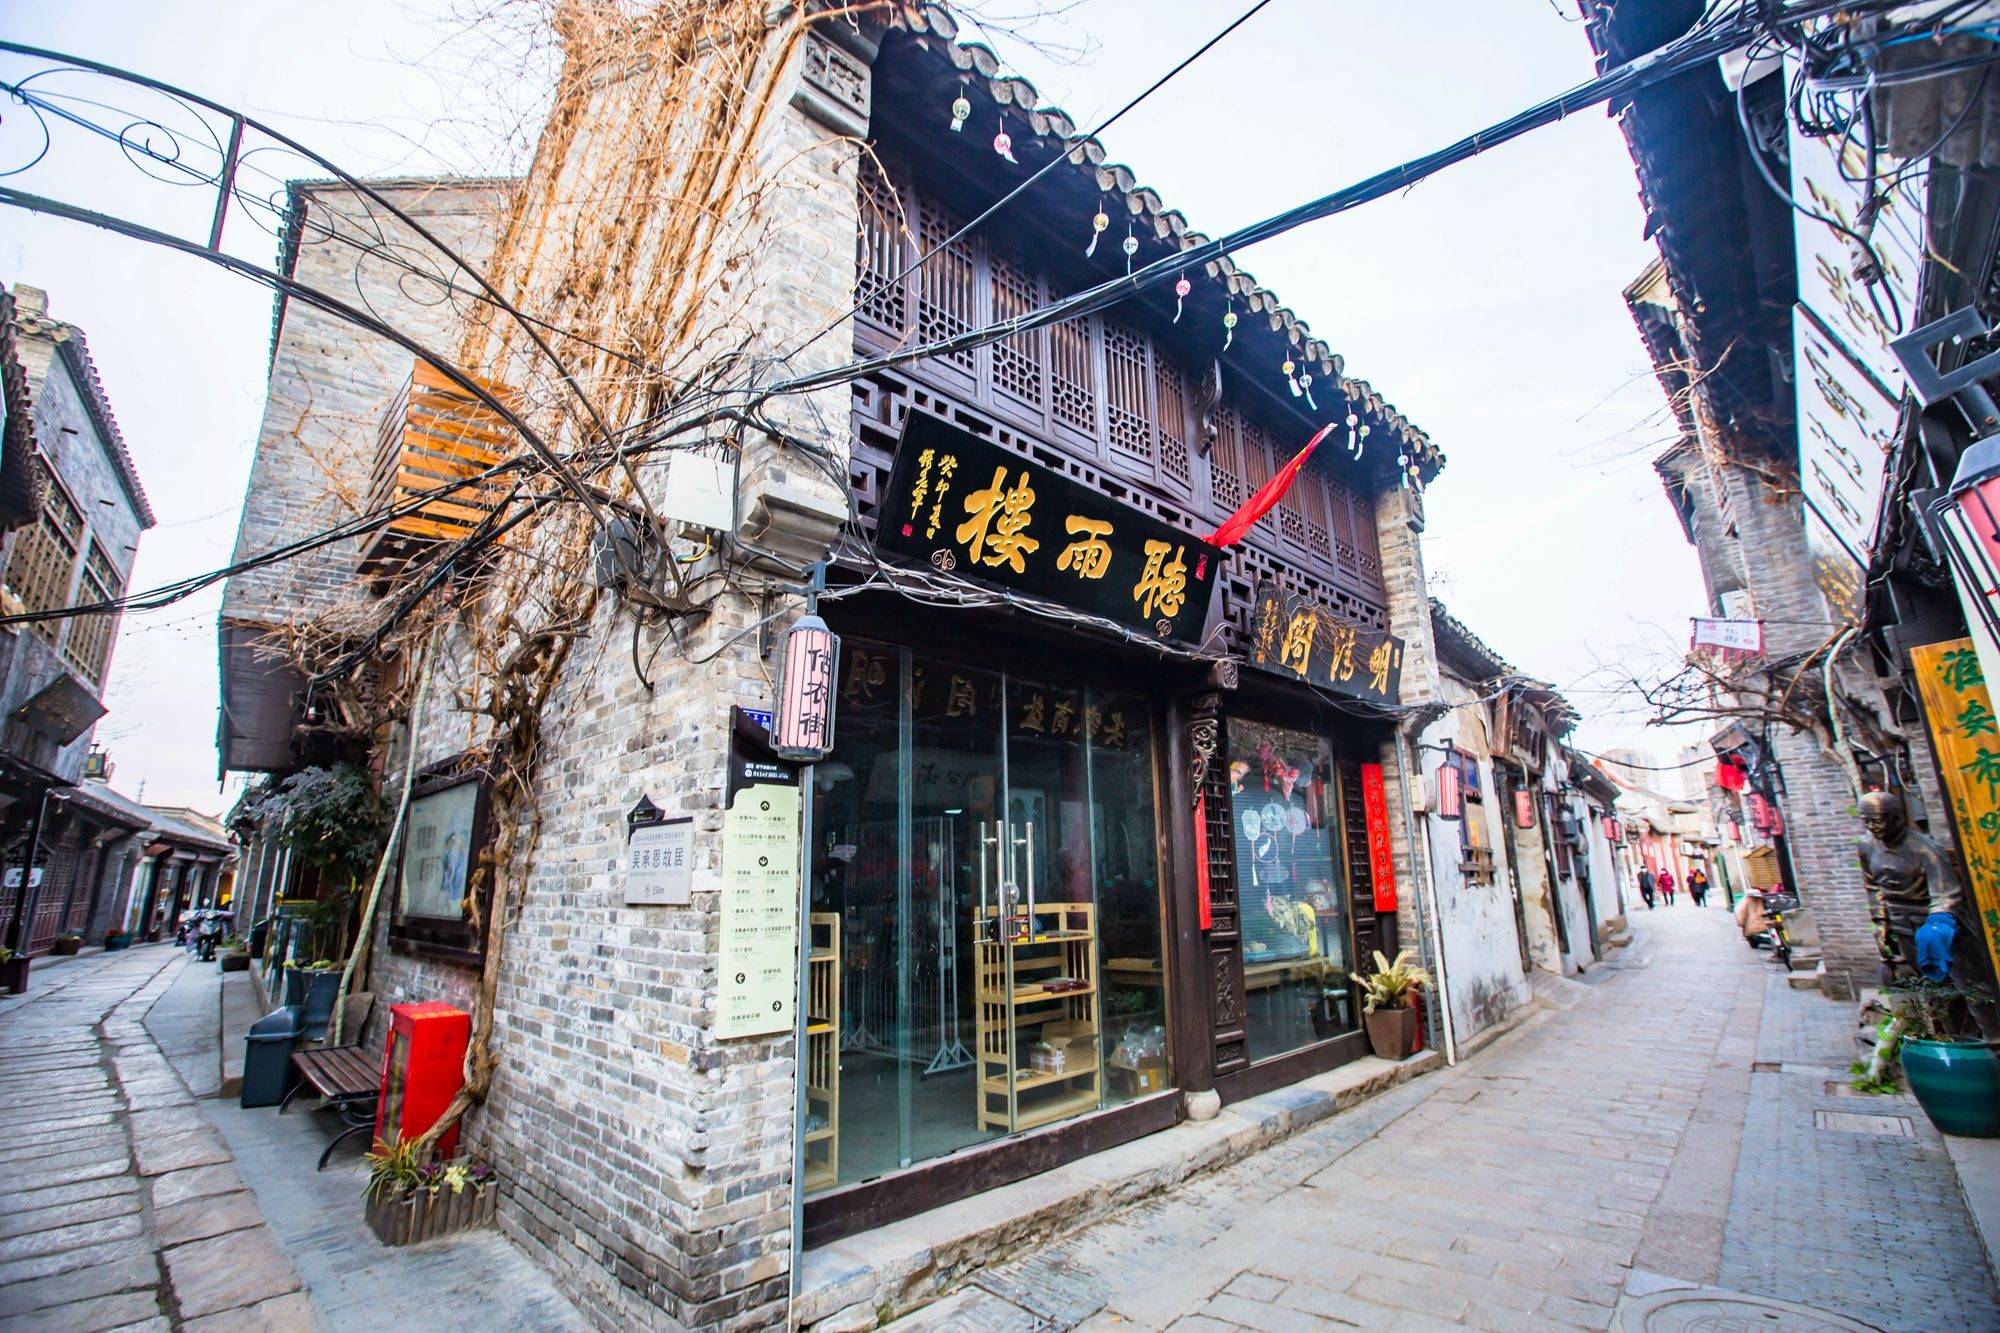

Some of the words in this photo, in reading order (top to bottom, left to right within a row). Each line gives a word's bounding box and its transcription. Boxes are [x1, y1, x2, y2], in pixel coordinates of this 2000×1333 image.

[955, 465, 1187, 620] 聽雨樓
[632, 847, 684, 869] 吴承恩故居
